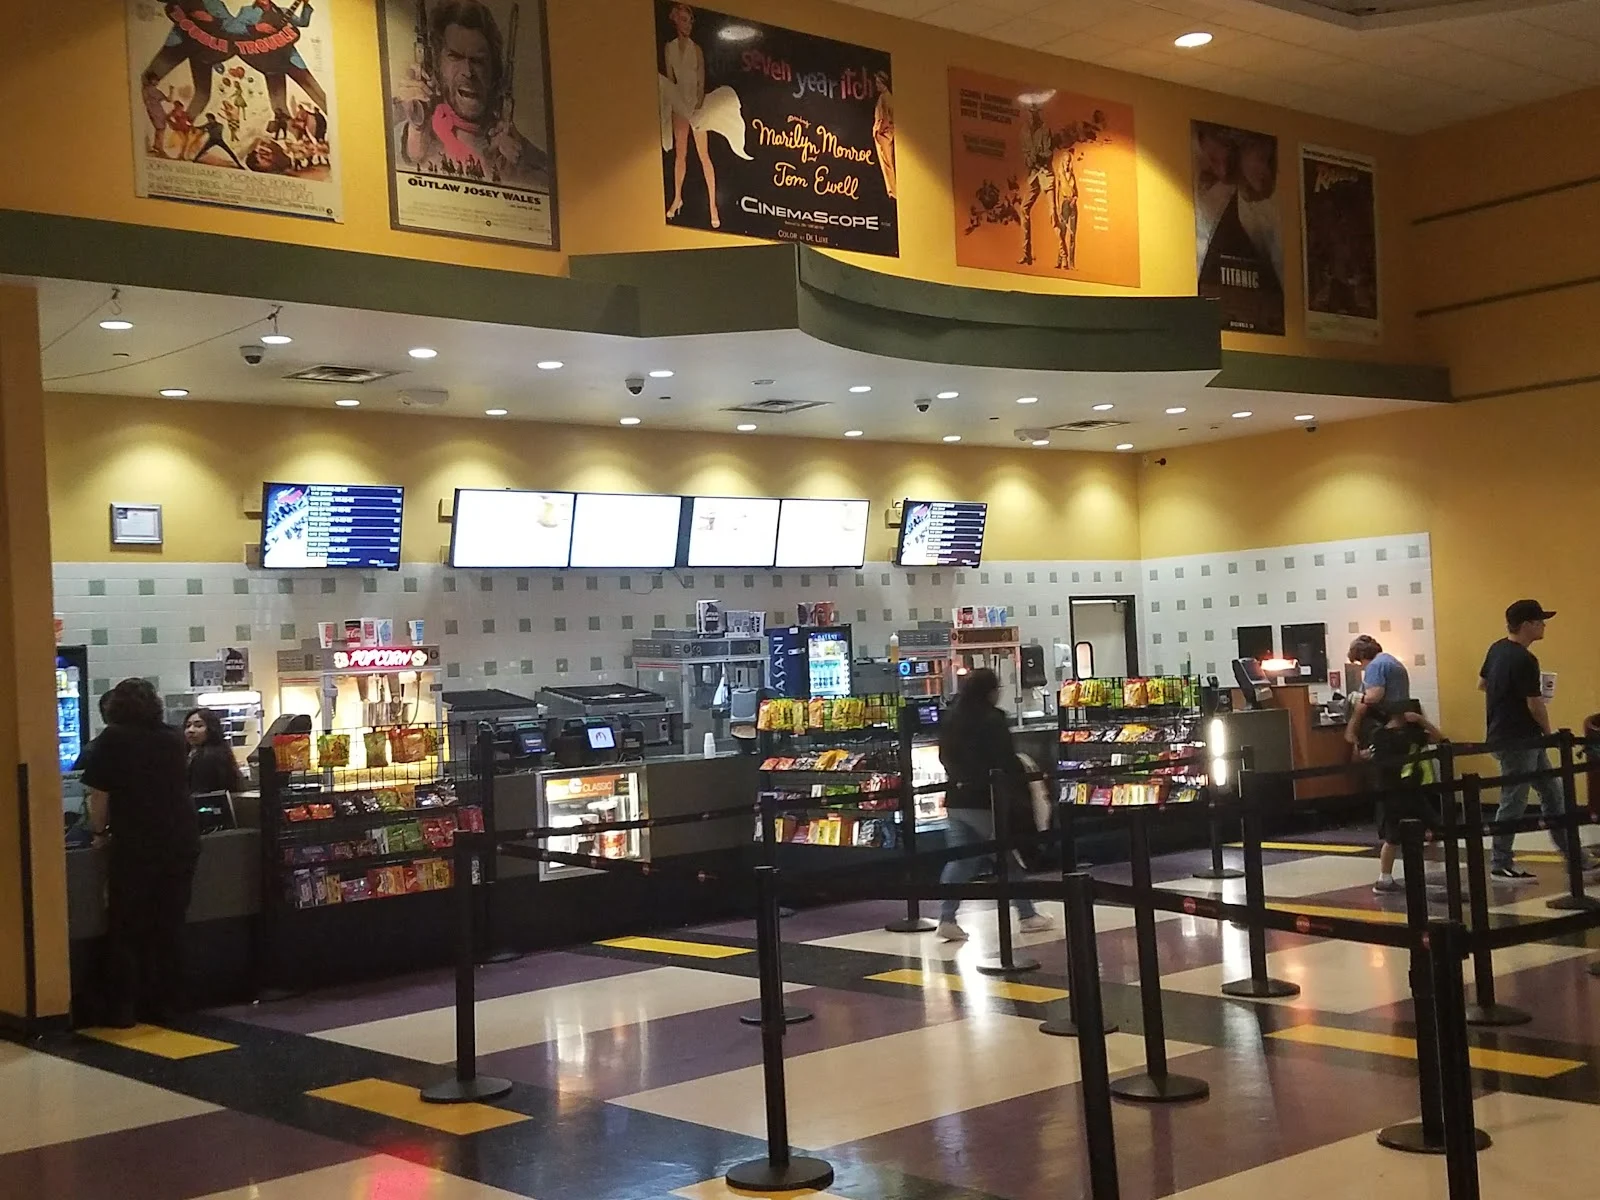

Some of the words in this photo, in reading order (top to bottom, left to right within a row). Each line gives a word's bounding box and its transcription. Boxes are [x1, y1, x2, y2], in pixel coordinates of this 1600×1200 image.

[234, 22, 298, 55] TROUBLE
[741, 50, 792, 82] seven
[792, 71, 838, 99] year
[840, 67, 873, 100] itch
[752, 118, 820, 163] Marilyn
[816, 125, 875, 165] Monroe
[407, 177, 460, 193] OUTLAW
[464, 186, 500, 199] JOSEY
[501, 191, 541, 205] WALES
[773, 161, 808, 187] Tom
[814, 165, 859, 200] Ewell
[740, 195, 880, 231] CINEMASCOPE
[777, 229, 798, 239] COLOR
[1220, 266, 1260, 289] TITANIC
[349, 648, 413, 667] POPCORN
[582, 782, 612, 792] CLASSIC
